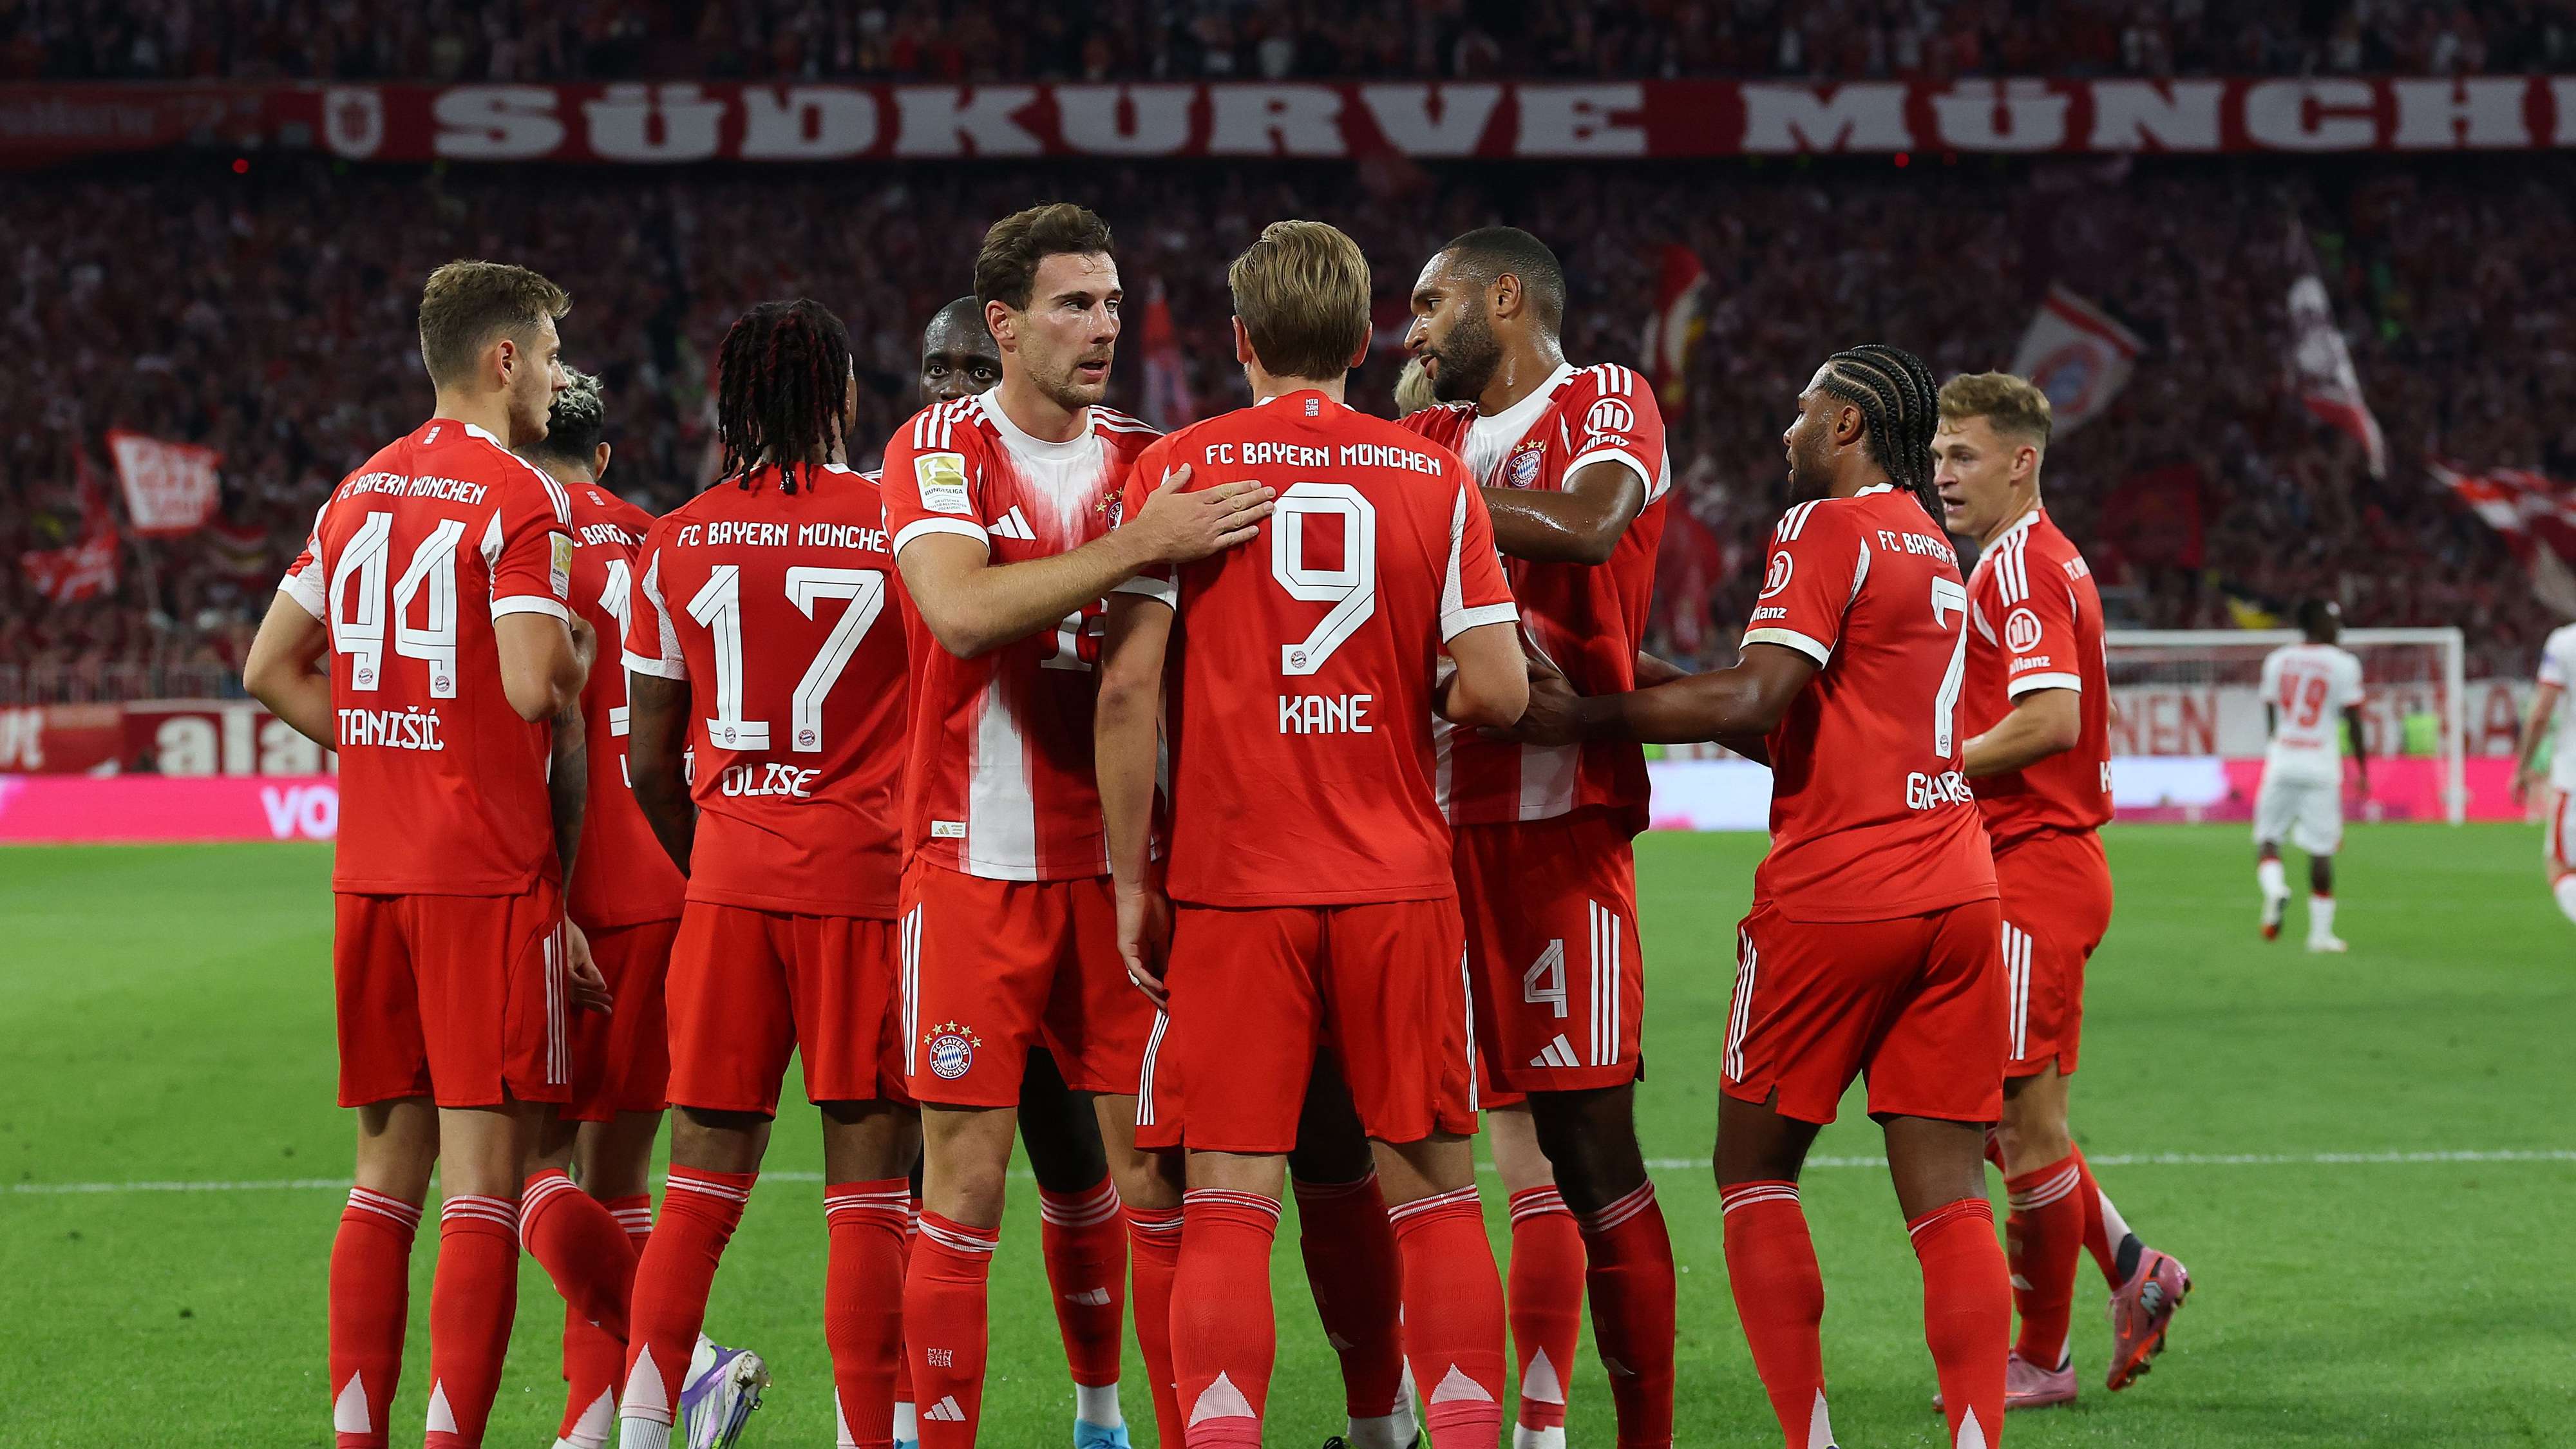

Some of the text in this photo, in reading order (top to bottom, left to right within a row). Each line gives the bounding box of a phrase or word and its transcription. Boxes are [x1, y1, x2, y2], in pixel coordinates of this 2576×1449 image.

[433, 77, 2576, 161] SÜDKURVE MÜNCH
[1206, 442, 1443, 477] FC BAYERN MÜNCHEN
[352, 471, 409, 497] BAYERN
[406, 475, 488, 506] MÜNCHEN
[677, 521, 891, 554] FC BAYERN MÜNCHE
[1877, 529, 1901, 553] FC
[1271, 482, 1376, 676] 9
[328, 511, 467, 699] 44
[686, 565, 885, 753] 17
[1931, 575, 1968, 759] 7
[337, 705, 445, 751] TANIŠIĆ
[1278, 694, 1373, 734] KANE
[156, 710, 339, 778] ala
[722, 762, 822, 799] OLISE
[1524, 938, 1568, 1018] 4
[933, 1037, 969, 1056] FC BAYERN
